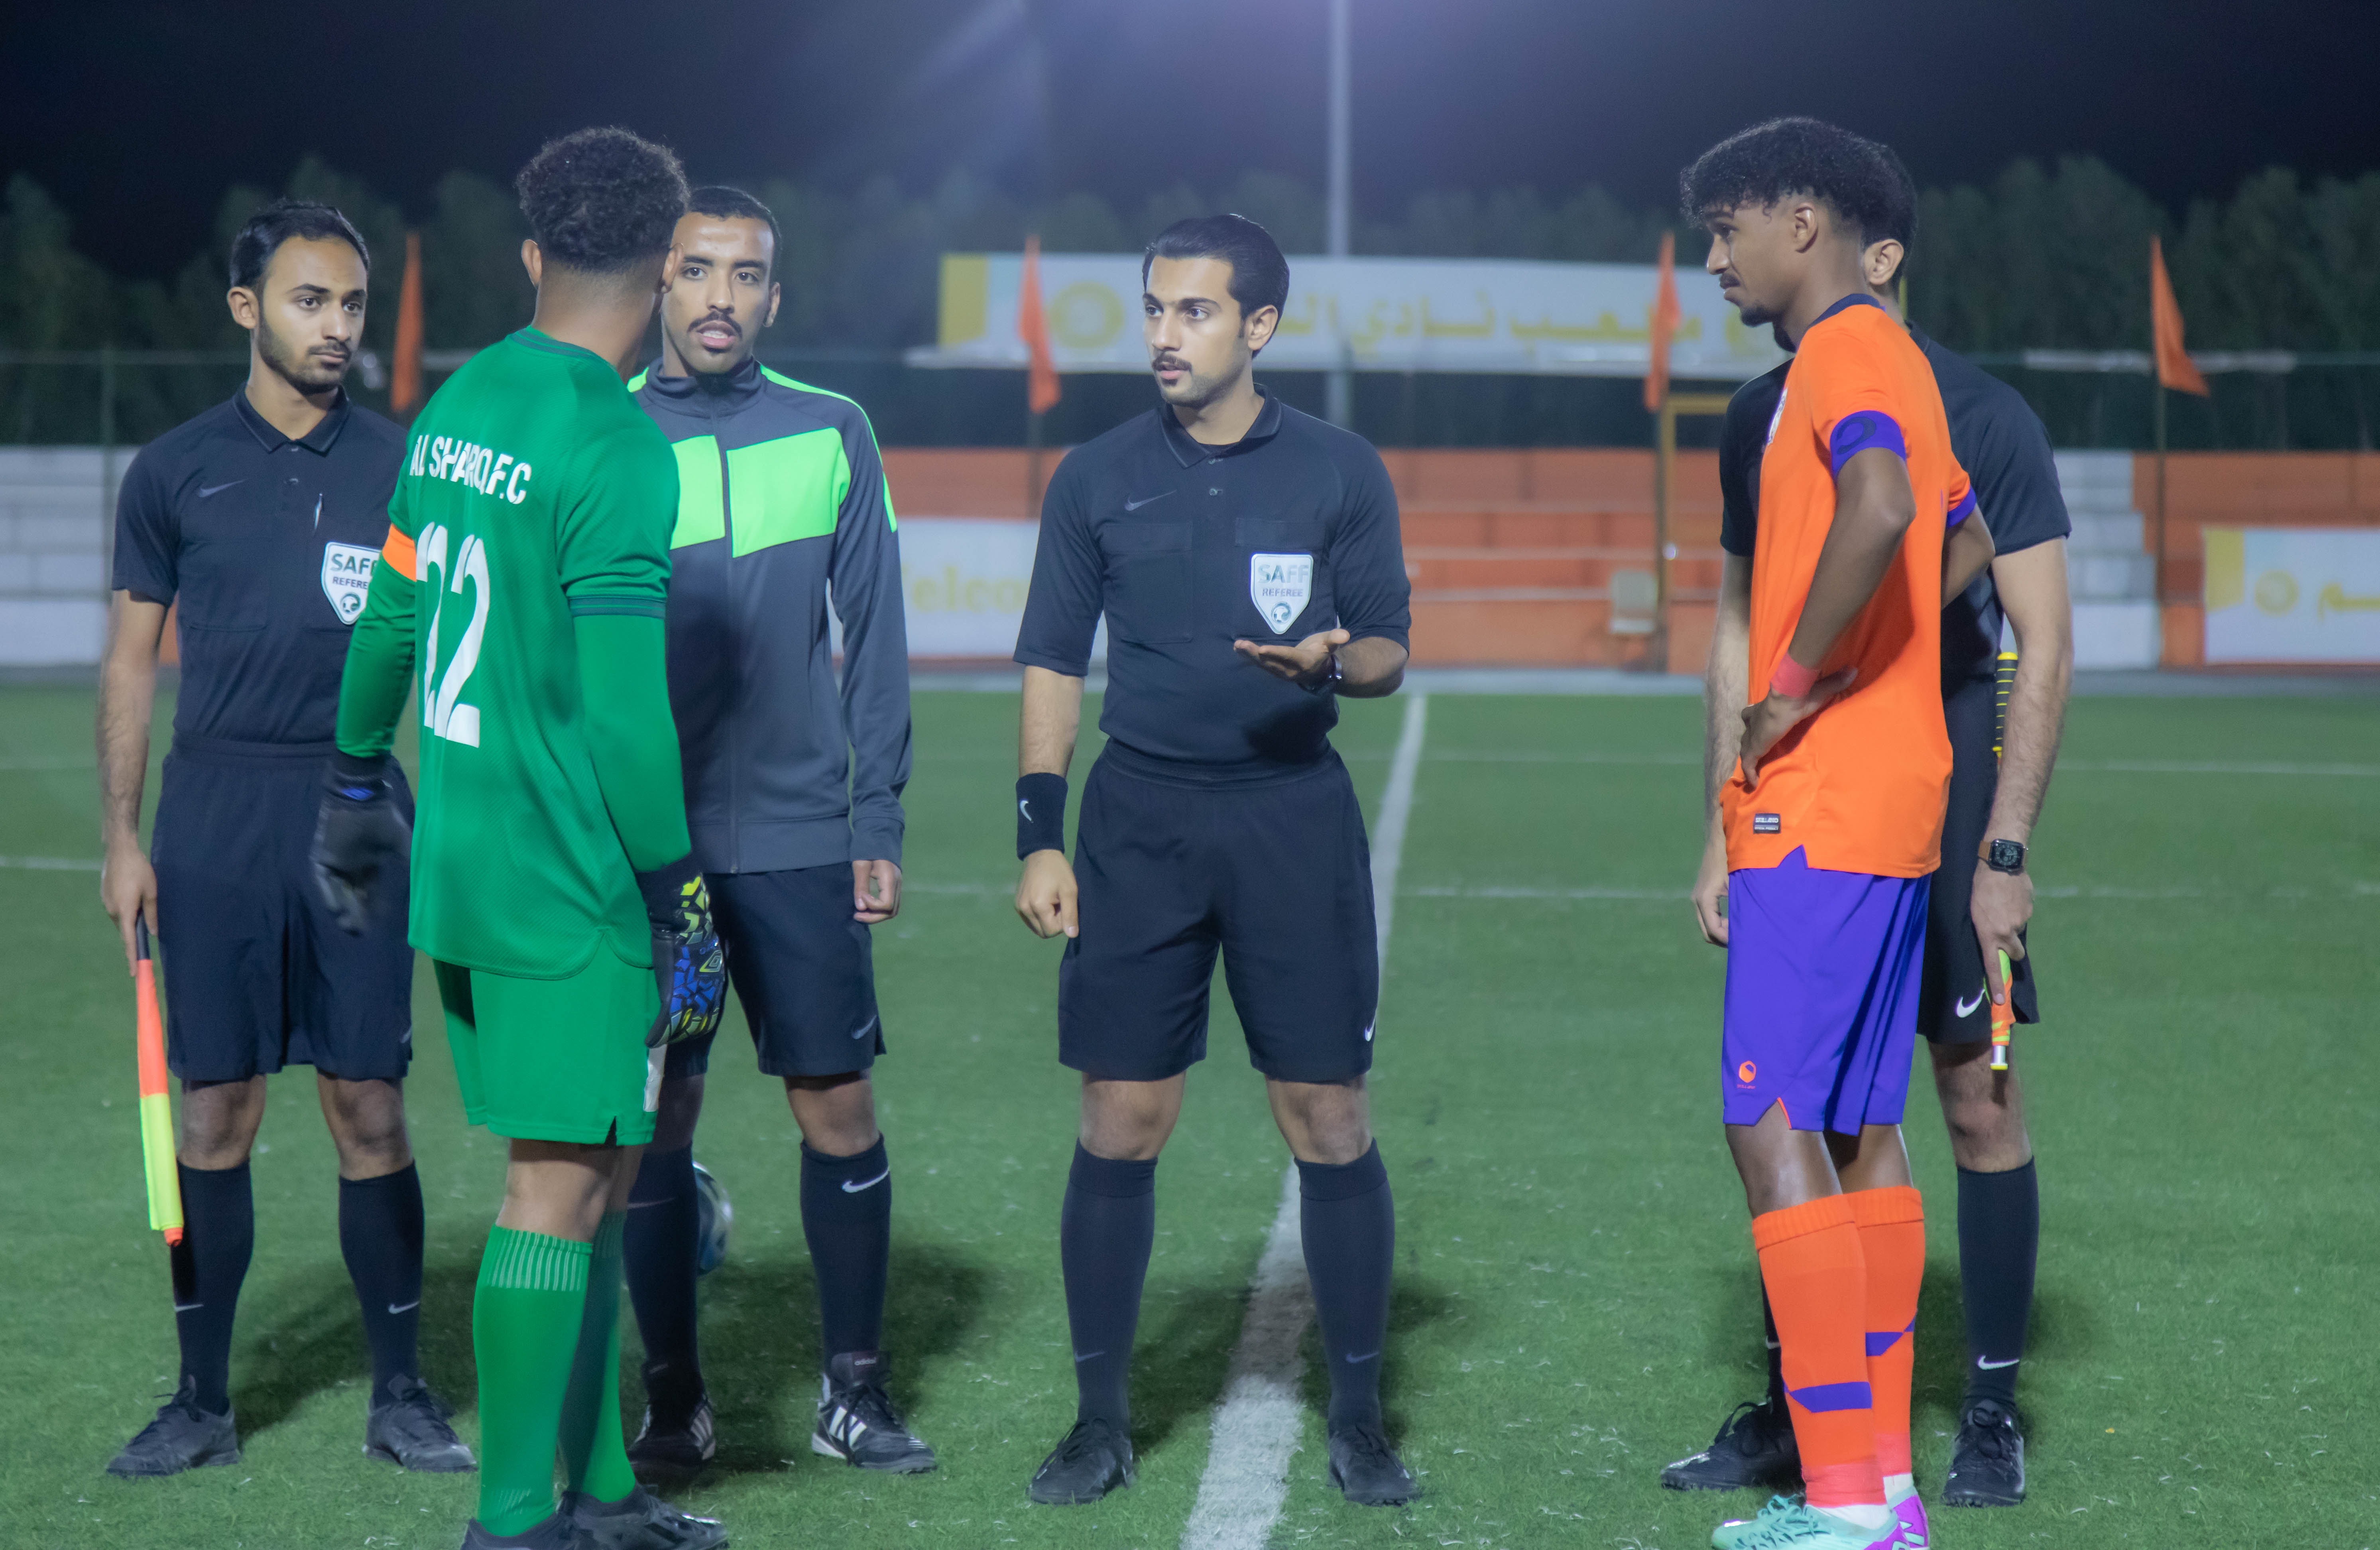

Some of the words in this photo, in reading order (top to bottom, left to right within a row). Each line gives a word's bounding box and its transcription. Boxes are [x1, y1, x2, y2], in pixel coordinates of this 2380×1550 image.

[409, 434, 429, 476] AL
[332, 576, 368, 590] REFERE
[1258, 564, 1309, 583] SAFF
[1262, 587, 1304, 597] REFEREE
[416, 522, 490, 748] 22
